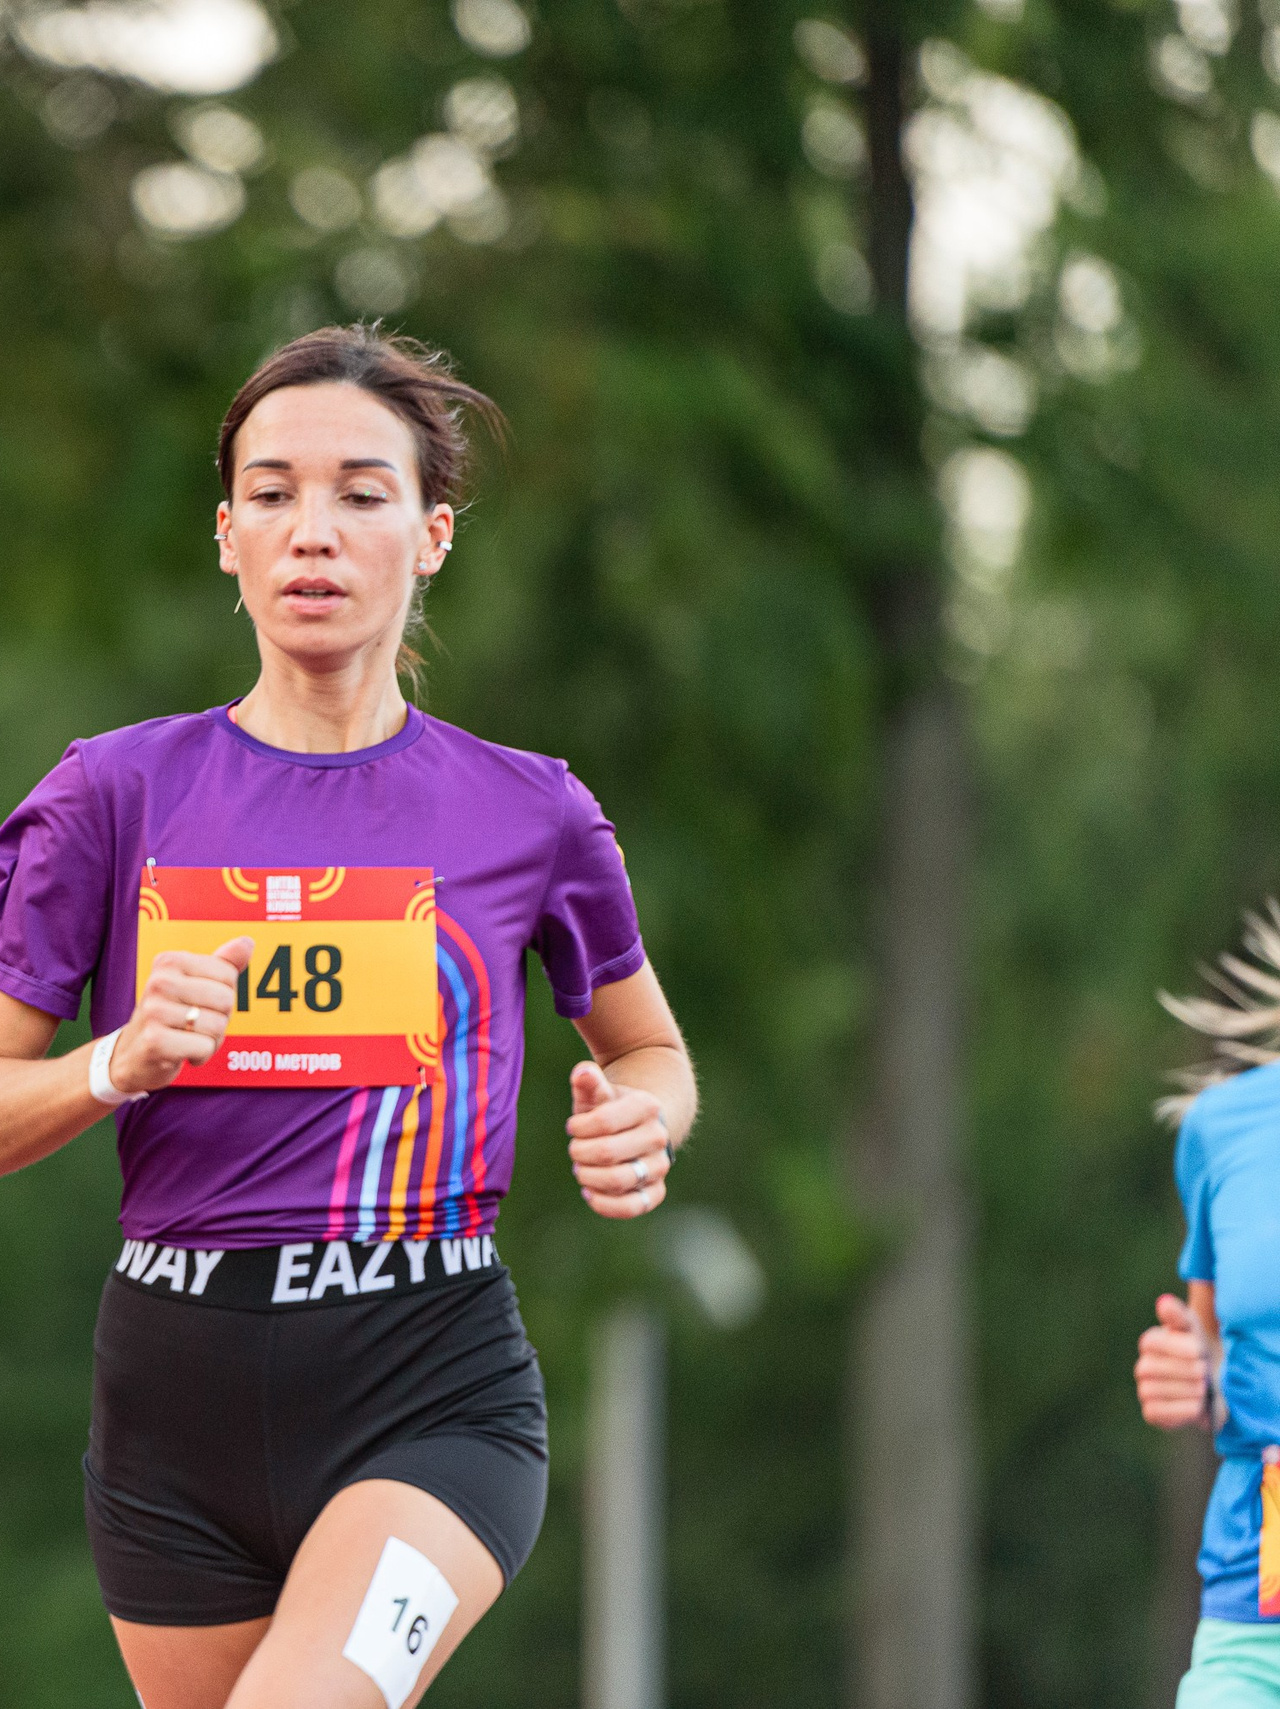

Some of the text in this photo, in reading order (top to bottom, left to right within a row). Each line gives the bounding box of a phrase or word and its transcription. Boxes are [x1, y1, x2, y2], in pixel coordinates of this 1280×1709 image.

[236, 944, 343, 1013] 148
[227, 1050, 342, 1074] 3000 метров
[115, 1238, 225, 1296] WAY
[392, 1597, 429, 1656] 16
